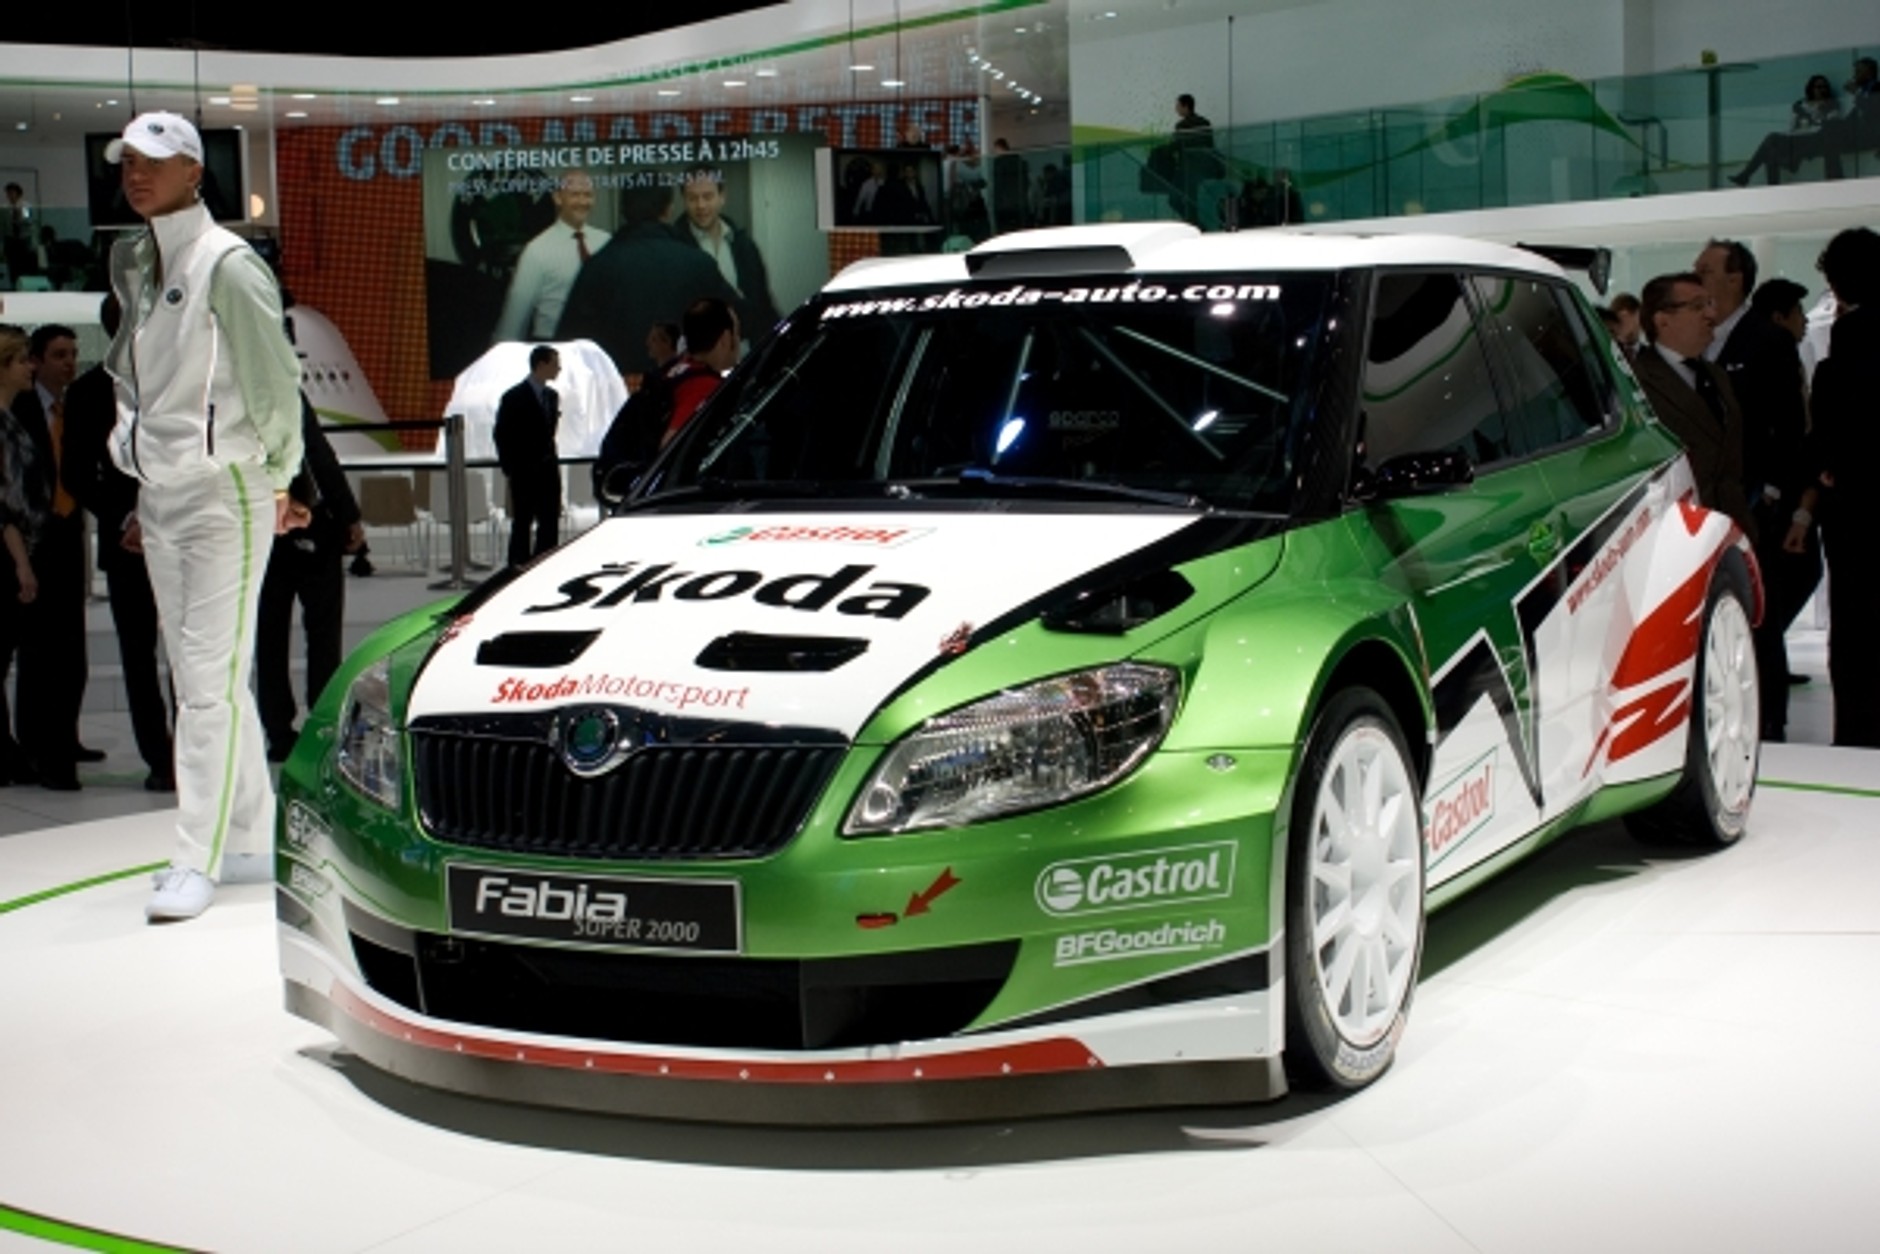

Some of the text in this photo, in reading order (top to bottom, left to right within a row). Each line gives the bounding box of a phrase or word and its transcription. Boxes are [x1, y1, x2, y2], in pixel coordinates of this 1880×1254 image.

[448, 138, 780, 171] CONFÉRENCE DE PRESSE À 12h45
[821, 279, 1281, 320] www.skoda-auto.com
[1432, 764, 1490, 851] Castrol
[1087, 851, 1220, 904] Castrol
[475, 877, 628, 922] Fabia
[573, 919, 700, 942] SUPER 2000
[1055, 918, 1227, 961] BFGoodrich
